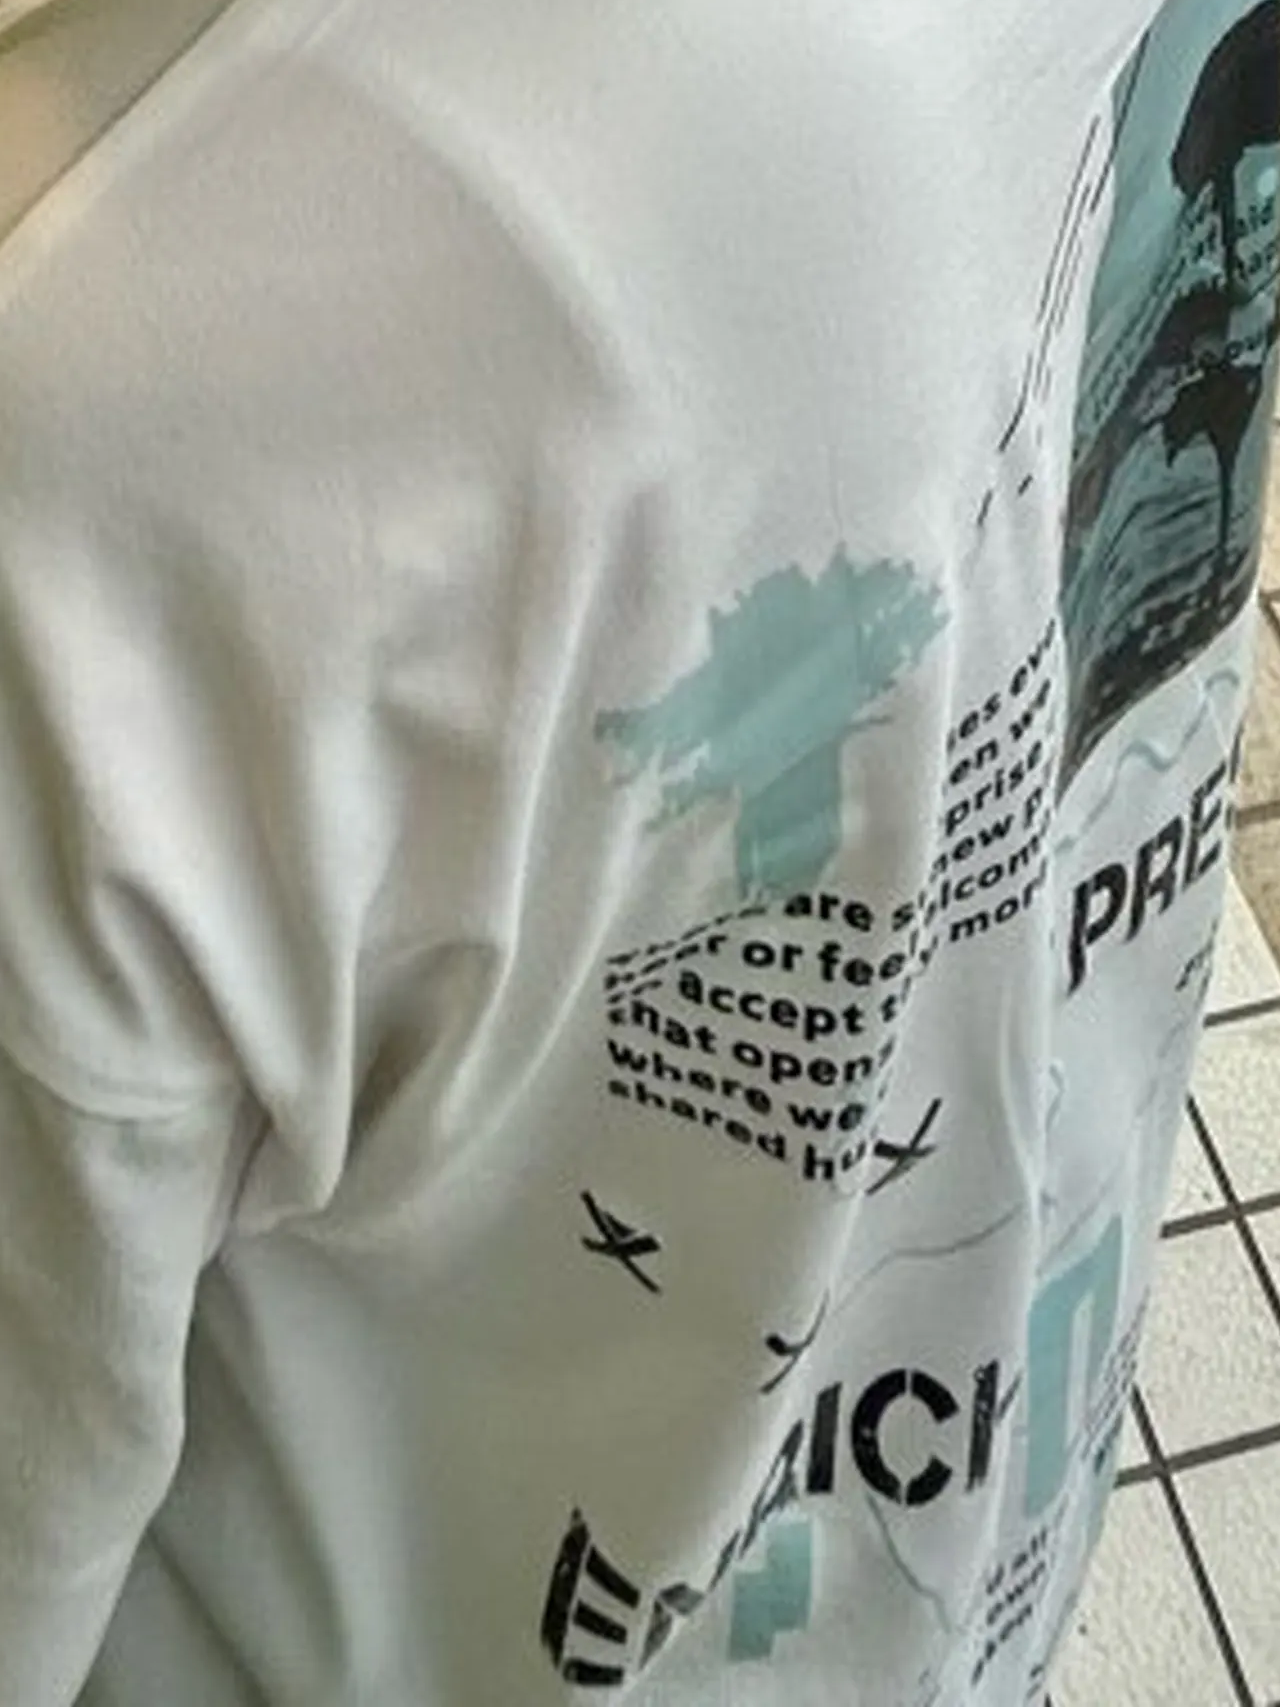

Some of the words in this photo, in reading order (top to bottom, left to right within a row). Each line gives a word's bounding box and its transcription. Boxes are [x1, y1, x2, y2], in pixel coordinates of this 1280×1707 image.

[1068, 724, 1244, 998] PRE
[783, 891, 874, 933] are
[741, 941, 804, 972] or
[677, 969, 866, 1043] accept
[607, 1036, 773, 1117] where
[607, 1080, 788, 1161] shared
